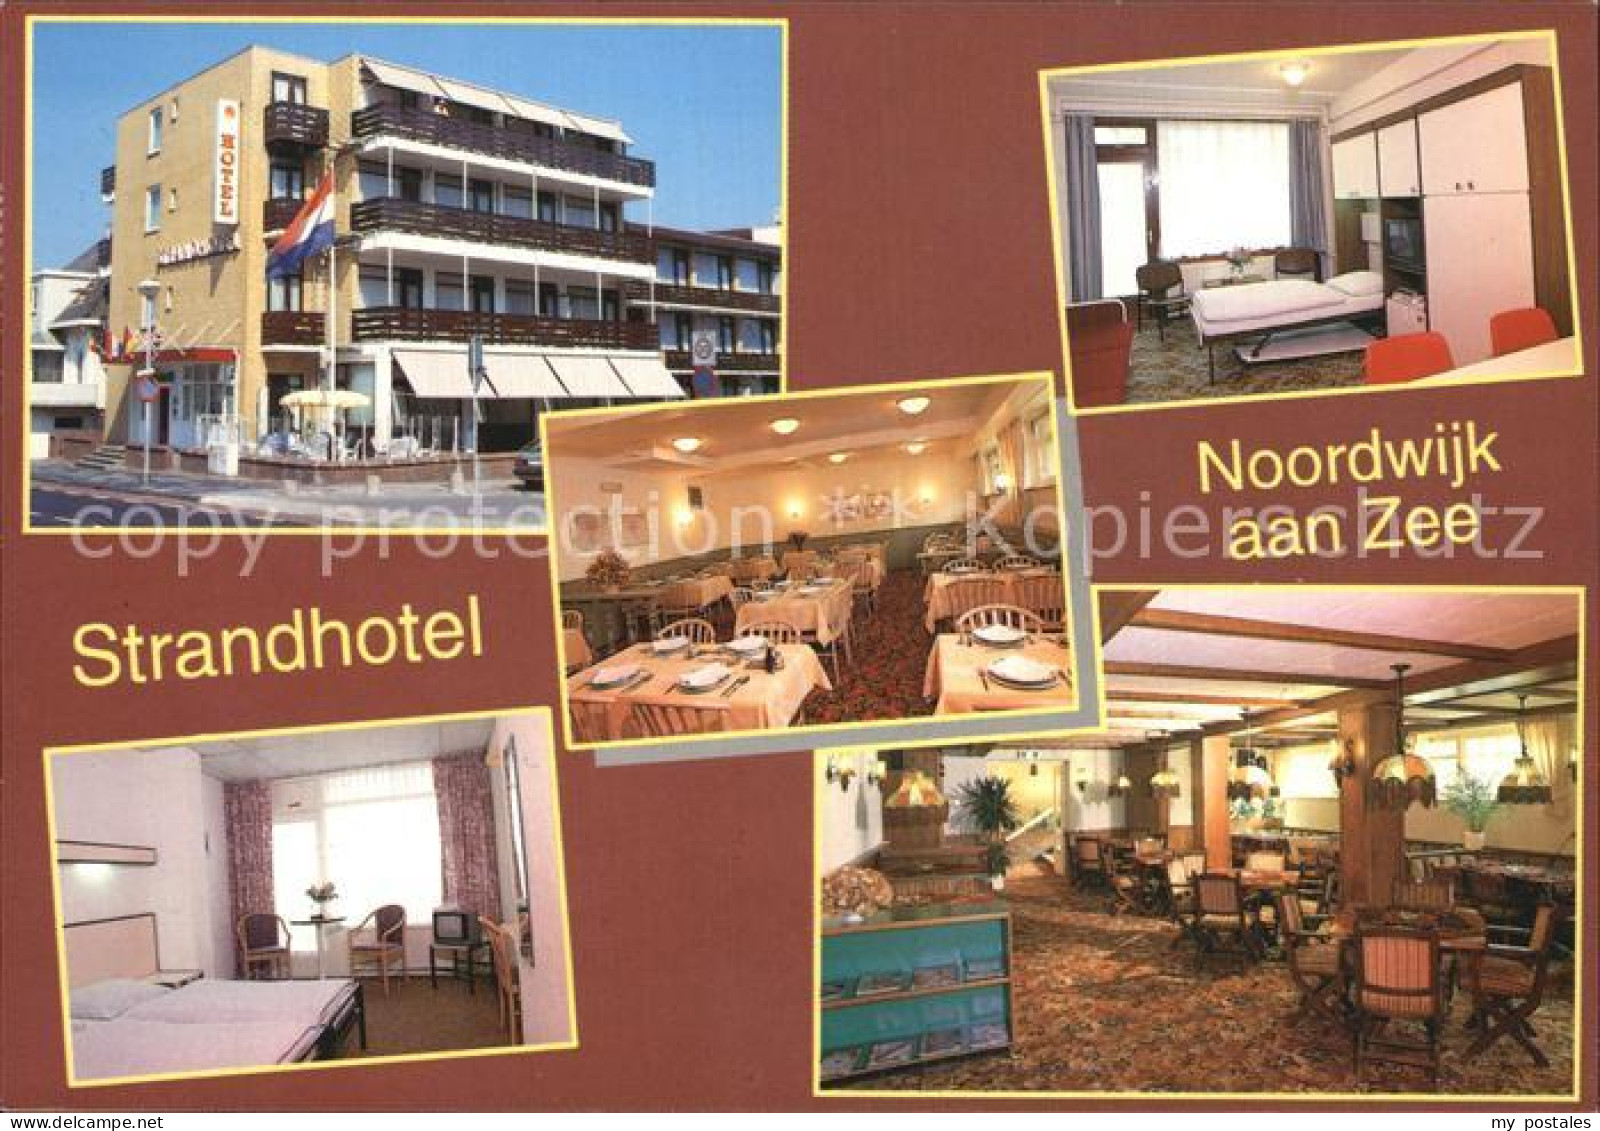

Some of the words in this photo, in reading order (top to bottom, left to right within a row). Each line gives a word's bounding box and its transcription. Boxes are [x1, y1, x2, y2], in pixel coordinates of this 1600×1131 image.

[220, 134, 235, 216] HOTEL
[1197, 421, 1502, 493] Noordwijk
[1227, 512, 1342, 561] aan
[1360, 496, 1481, 551] Zee
[73, 595, 483, 687] Strandhotel
